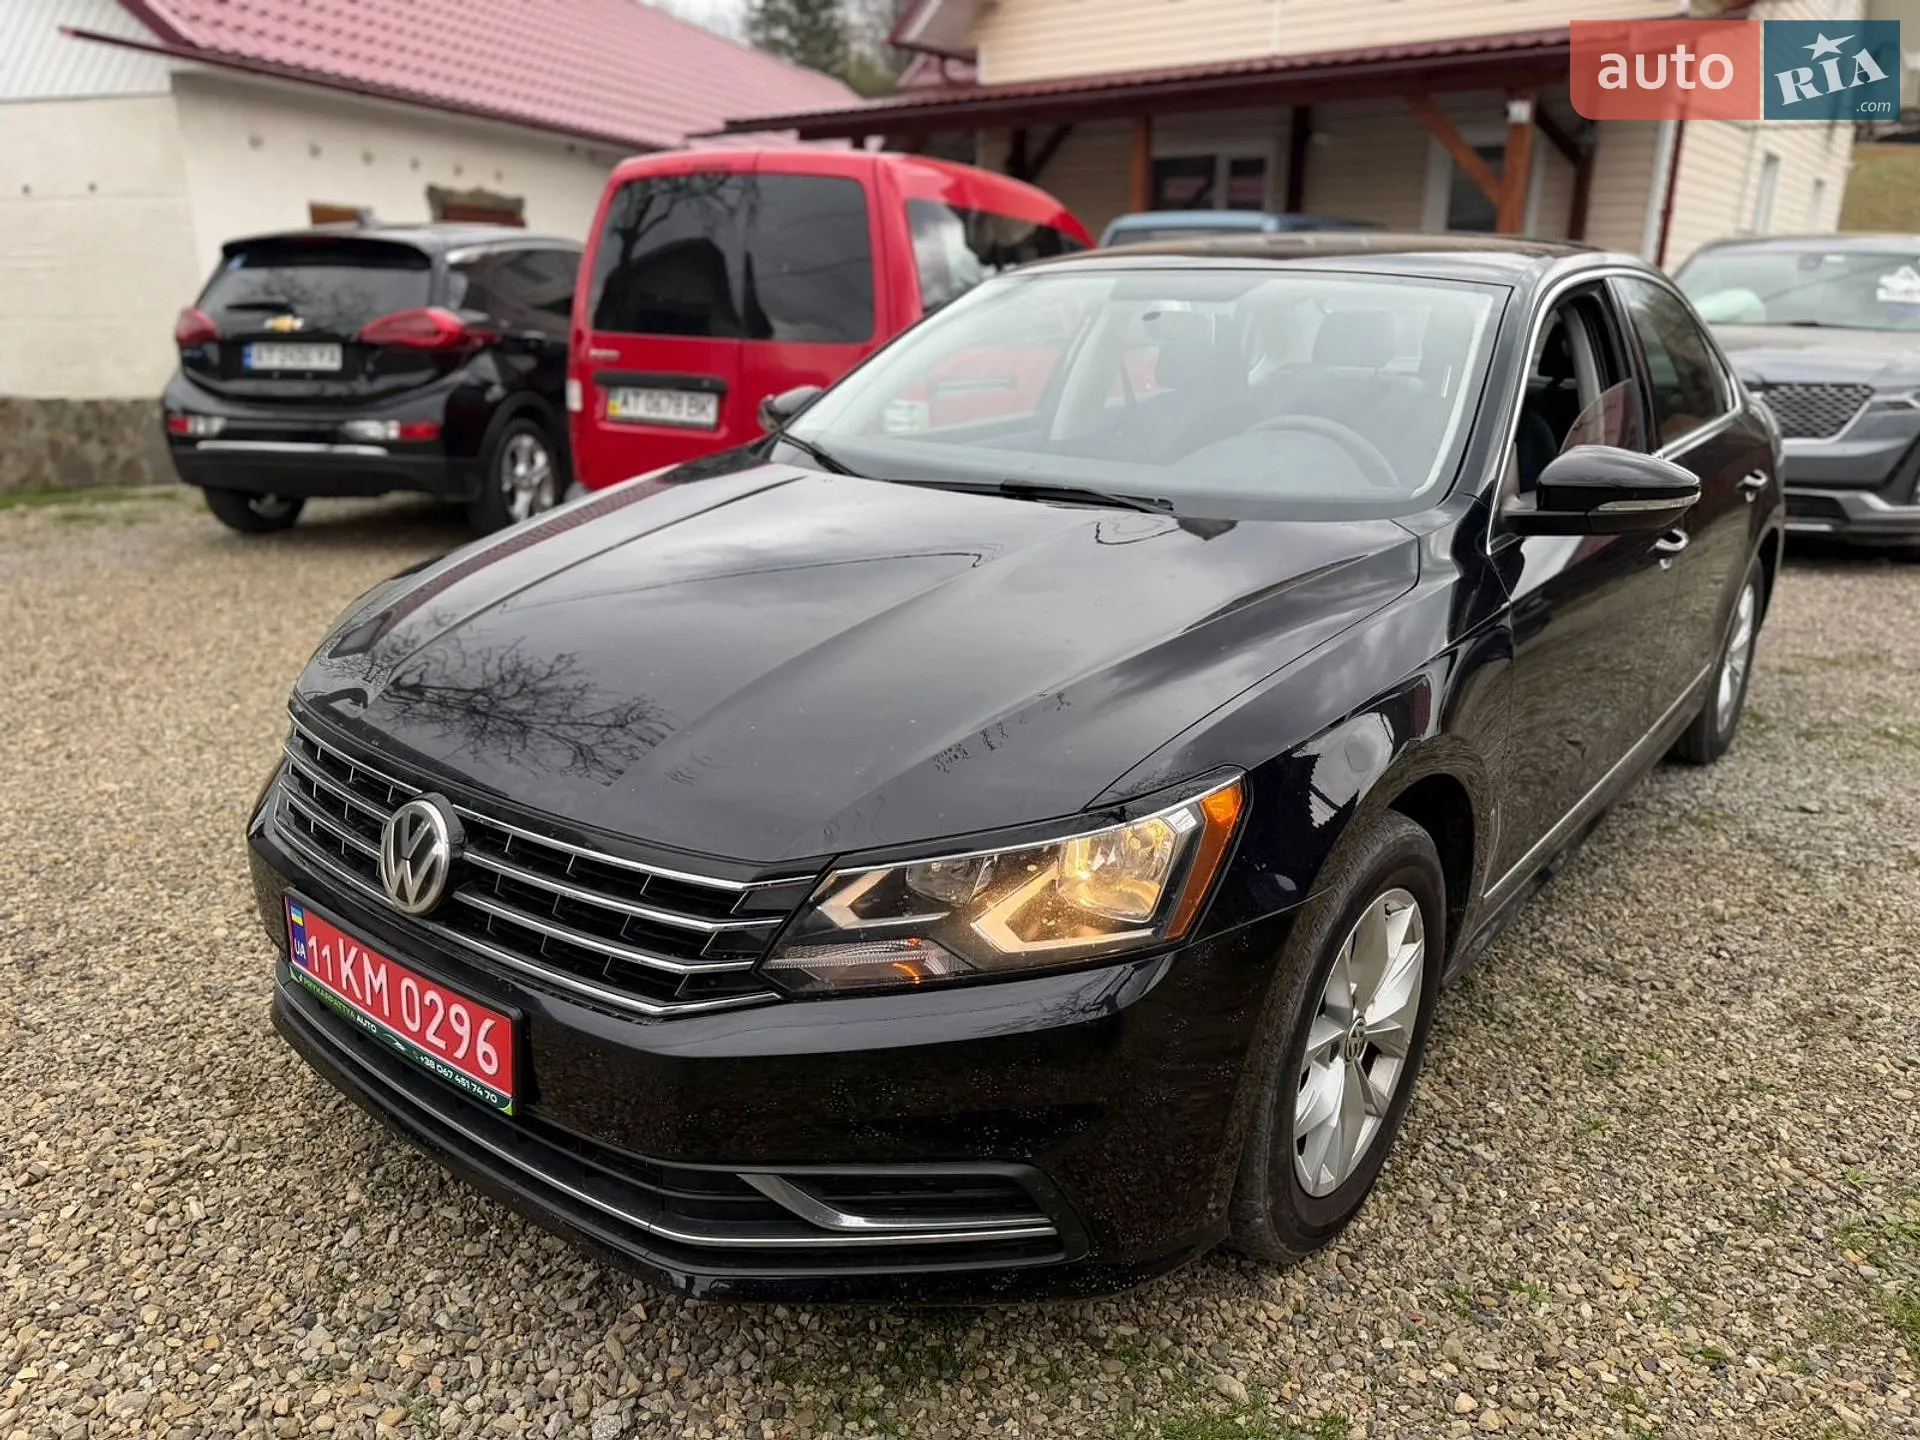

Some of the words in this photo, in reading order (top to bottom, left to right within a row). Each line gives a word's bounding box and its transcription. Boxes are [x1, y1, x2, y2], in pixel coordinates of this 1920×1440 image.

[294, 938, 307, 960] UA
[356, 1015, 377, 1034] AUTO
[401, 977, 499, 1076] 0296
[436, 1064, 454, 1079] 067
